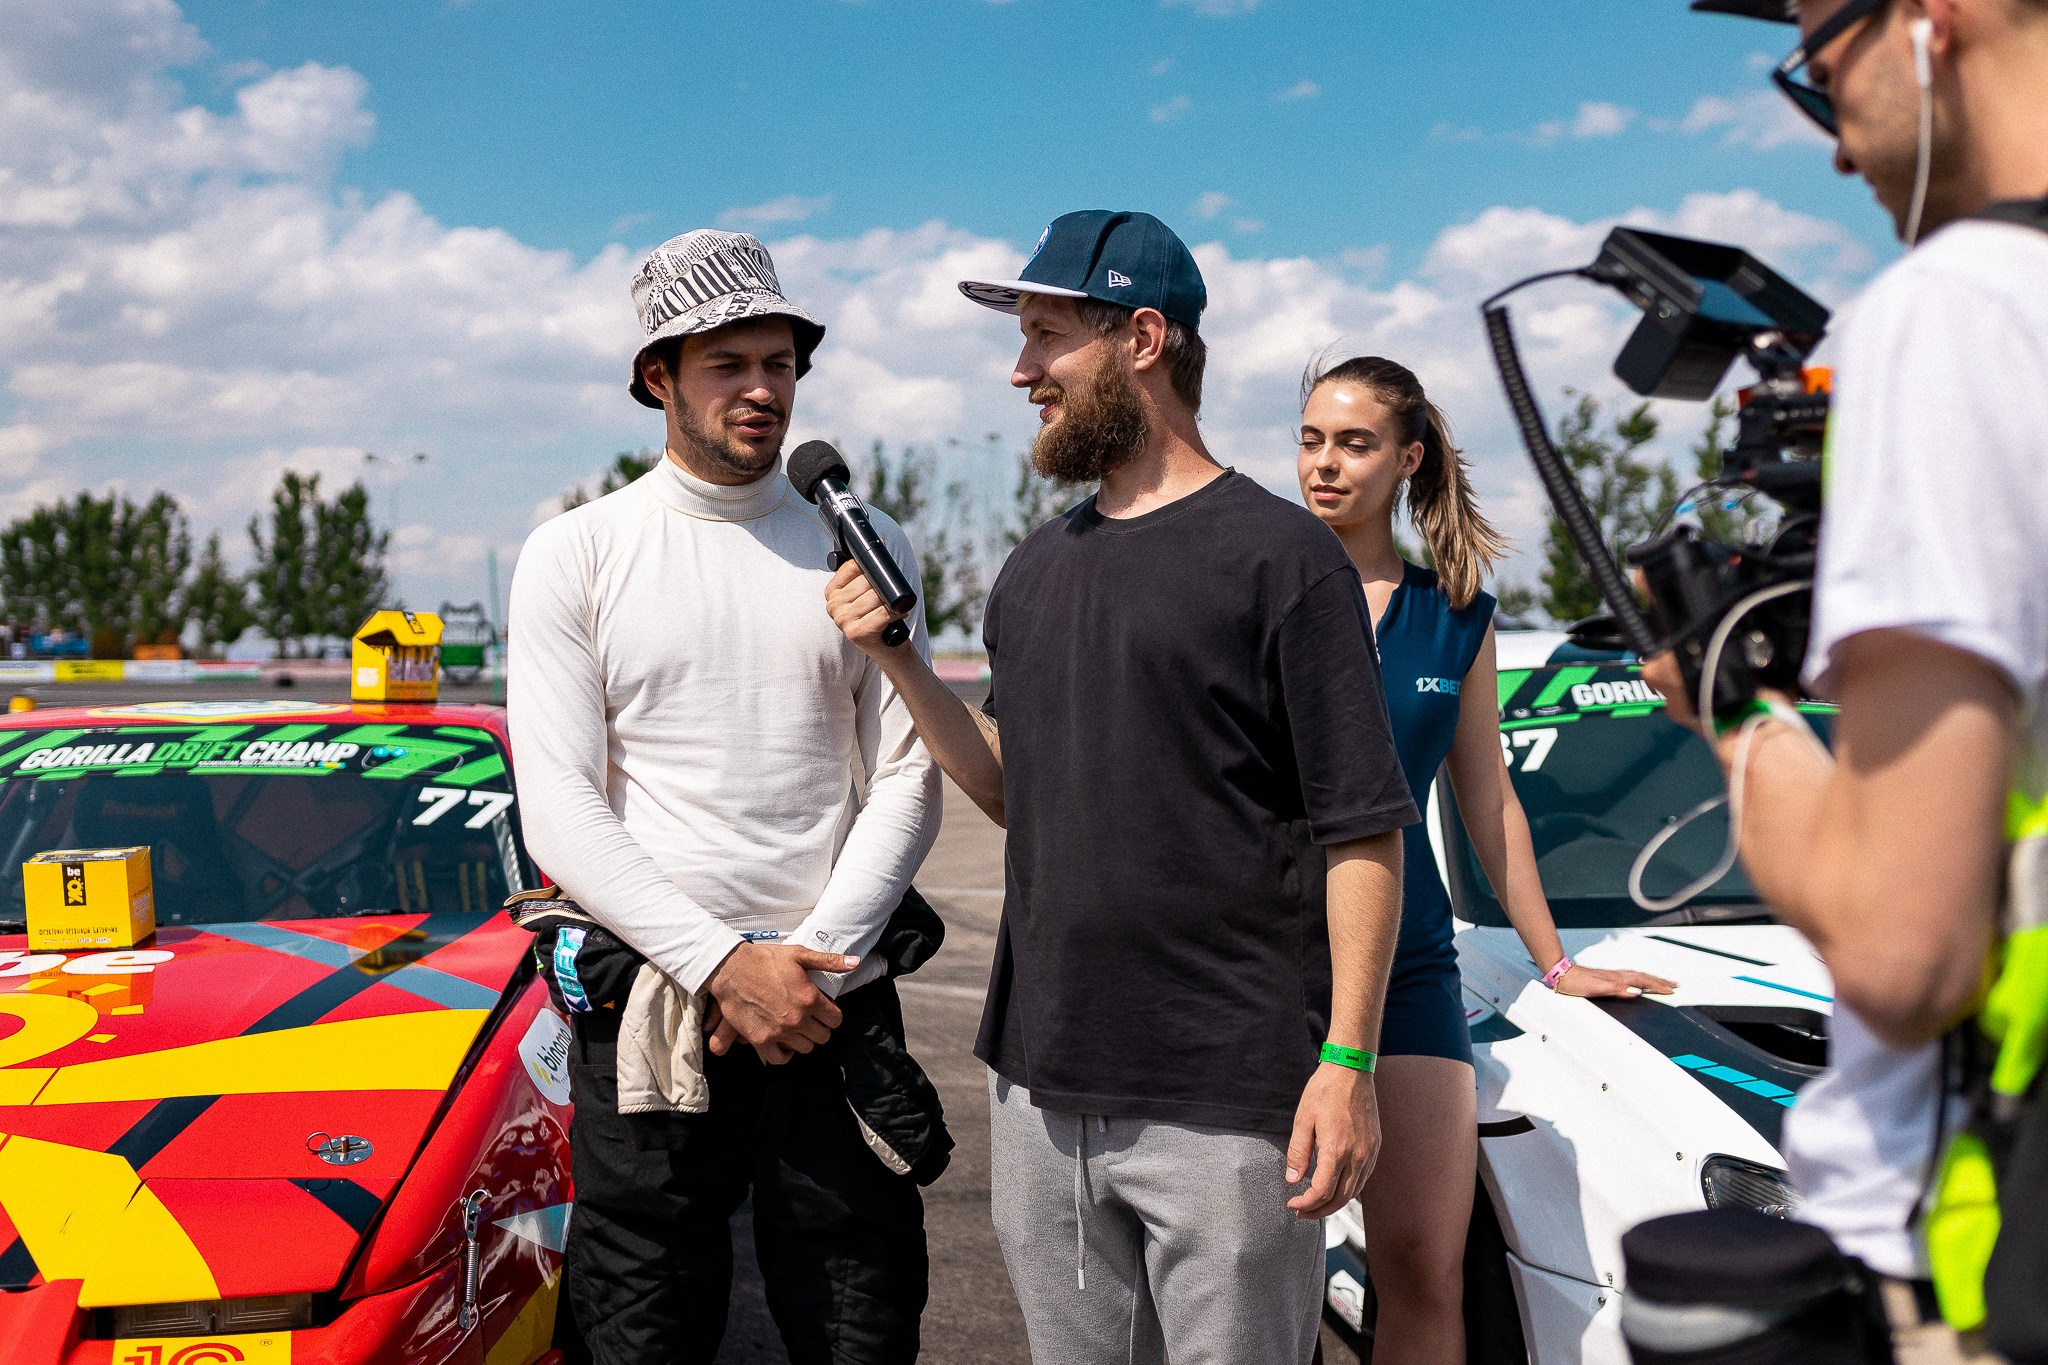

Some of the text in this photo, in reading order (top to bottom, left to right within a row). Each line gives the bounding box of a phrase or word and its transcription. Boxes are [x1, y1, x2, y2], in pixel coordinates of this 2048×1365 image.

[20, 742, 155, 769] GORILLA
[240, 741, 359, 763] CHAMP
[412, 787, 514, 829] 77
